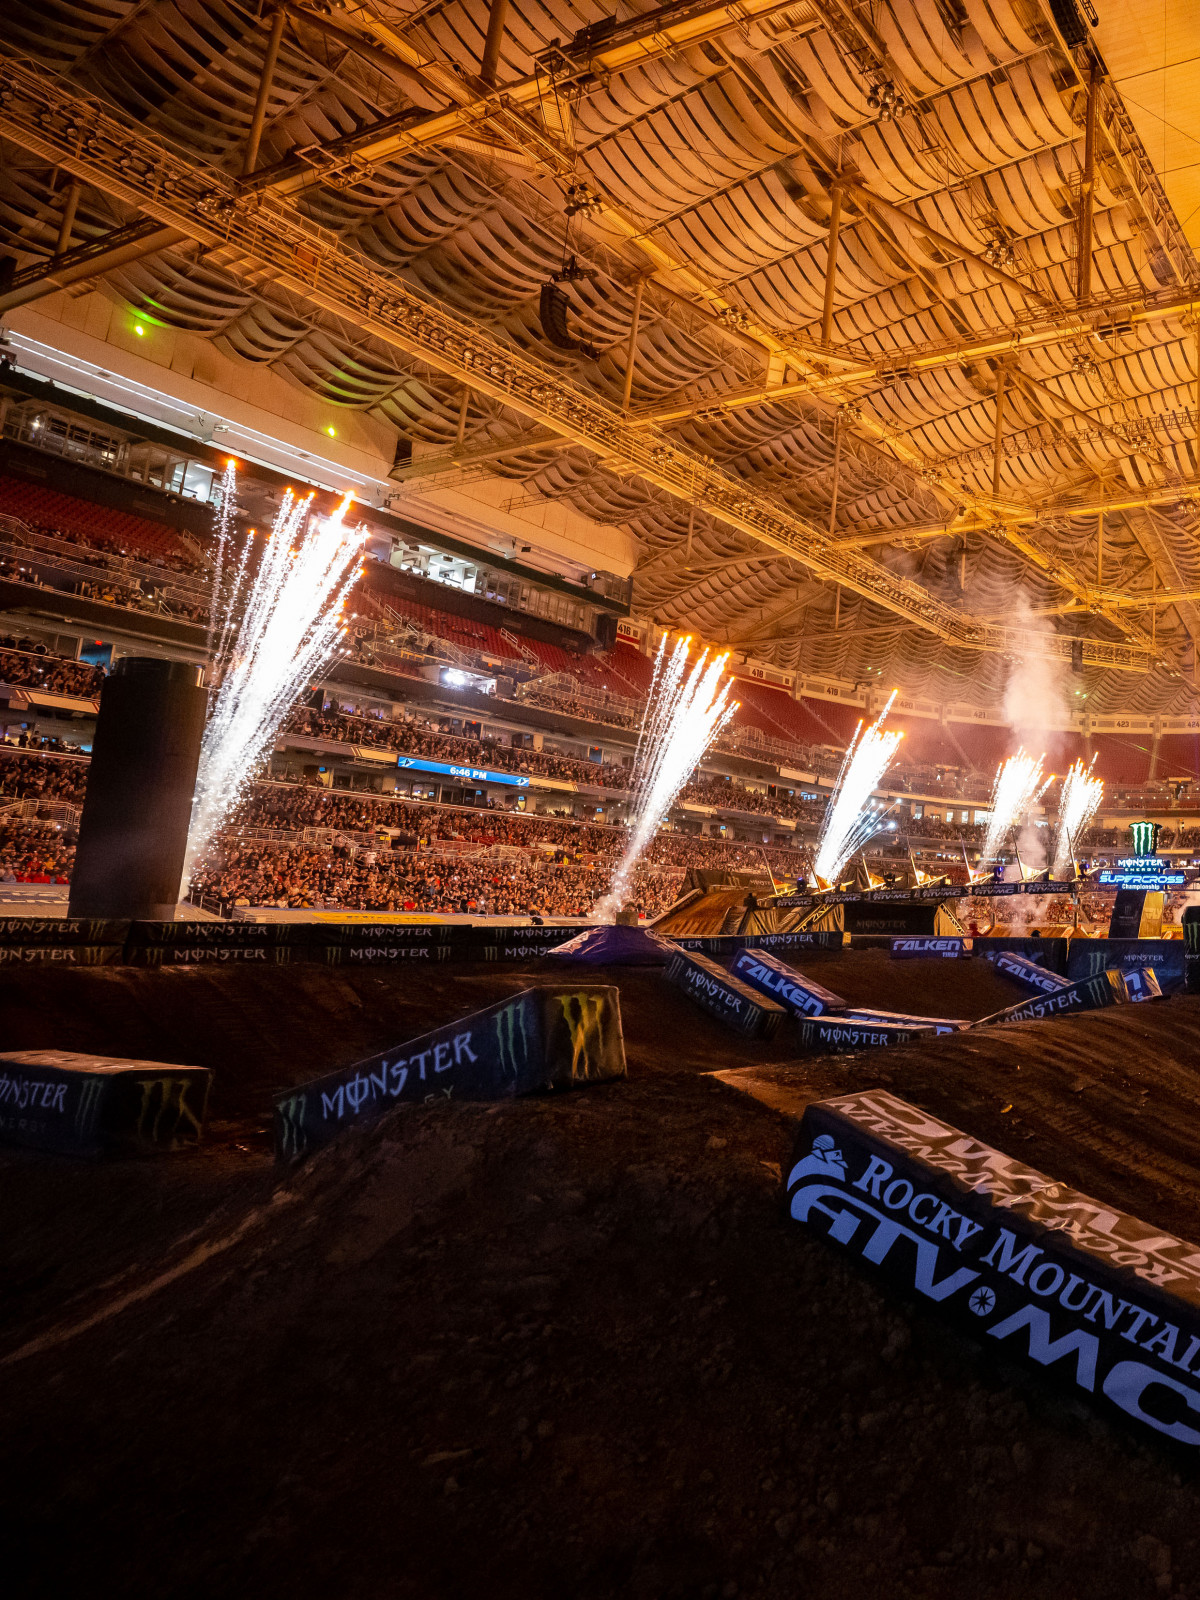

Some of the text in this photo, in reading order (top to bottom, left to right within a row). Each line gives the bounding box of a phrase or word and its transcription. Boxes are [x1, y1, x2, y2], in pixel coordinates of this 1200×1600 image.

[617, 623, 632, 635] 416
[751, 668, 765, 678] 418
[825, 685, 839, 696] 419
[973, 710, 987, 719] 421
[1116, 720, 1130, 728] 423
[1187, 720, 1200, 729] 424
[450, 767, 487, 779] 6:46 PM
[1099, 874, 1185, 884] SUPERCROSS
[760, 934, 814, 945] MONSTER
[893, 940, 960, 951] FALKEN
[0, 947, 76, 962] ONSTER
[505, 946, 548, 957] MONS
[736, 955, 823, 1017] FALKEN
[819, 1027, 888, 1046] MONSTER
[321, 1031, 478, 1120] MONSTER
[0, 1071, 69, 1113] ONSTER
[851, 1154, 985, 1252] ROCKY
